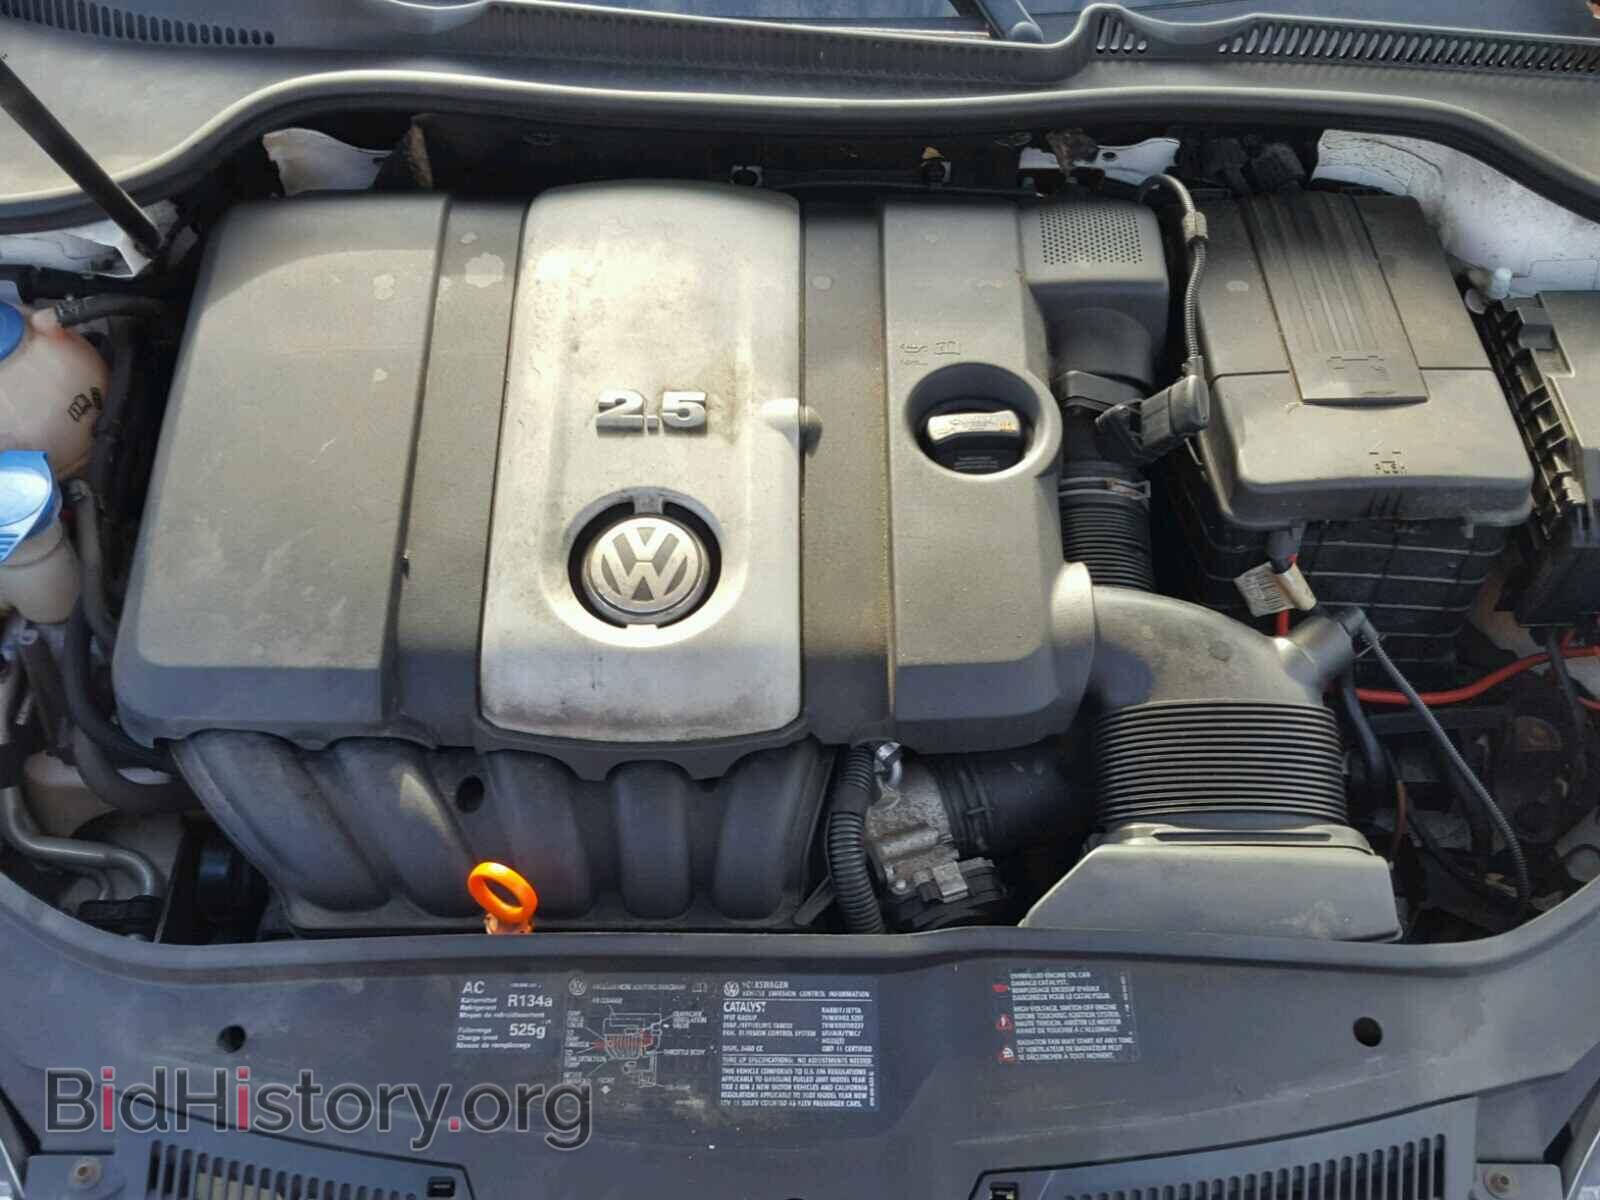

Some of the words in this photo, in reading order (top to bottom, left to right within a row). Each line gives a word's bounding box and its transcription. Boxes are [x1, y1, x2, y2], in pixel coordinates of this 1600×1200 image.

[596, 389, 708, 438] 2.5
[462, 980, 486, 994] AC
[508, 994, 552, 1008] R134a
[723, 1002, 767, 1012] CATALYST
[509, 1023, 546, 1040] 525g
